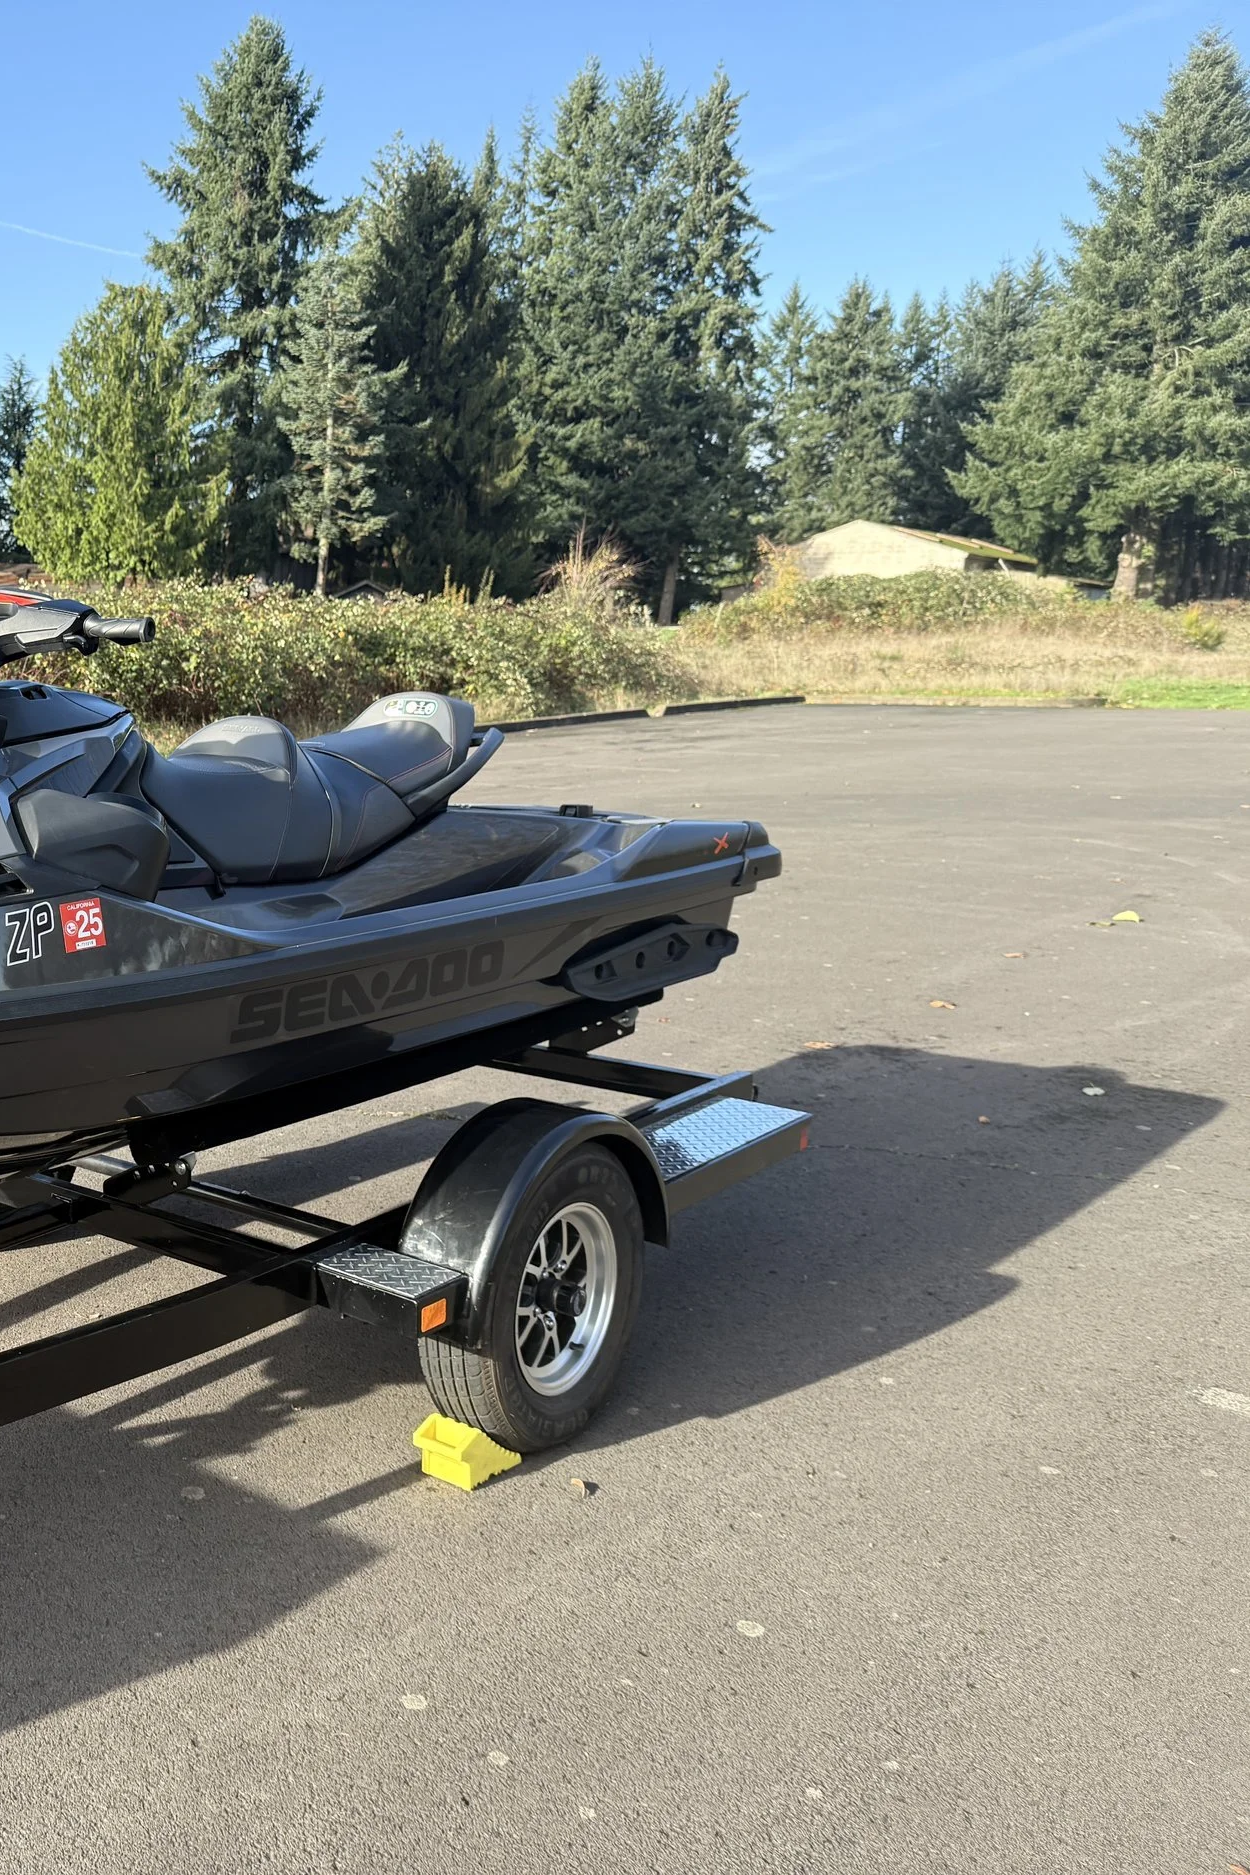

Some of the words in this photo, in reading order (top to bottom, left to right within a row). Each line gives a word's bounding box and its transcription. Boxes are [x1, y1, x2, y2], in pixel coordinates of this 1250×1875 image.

[66, 900, 96, 911] CALIFORNIA
[5, 901, 55, 967] ZP
[75, 907, 104, 939] 25
